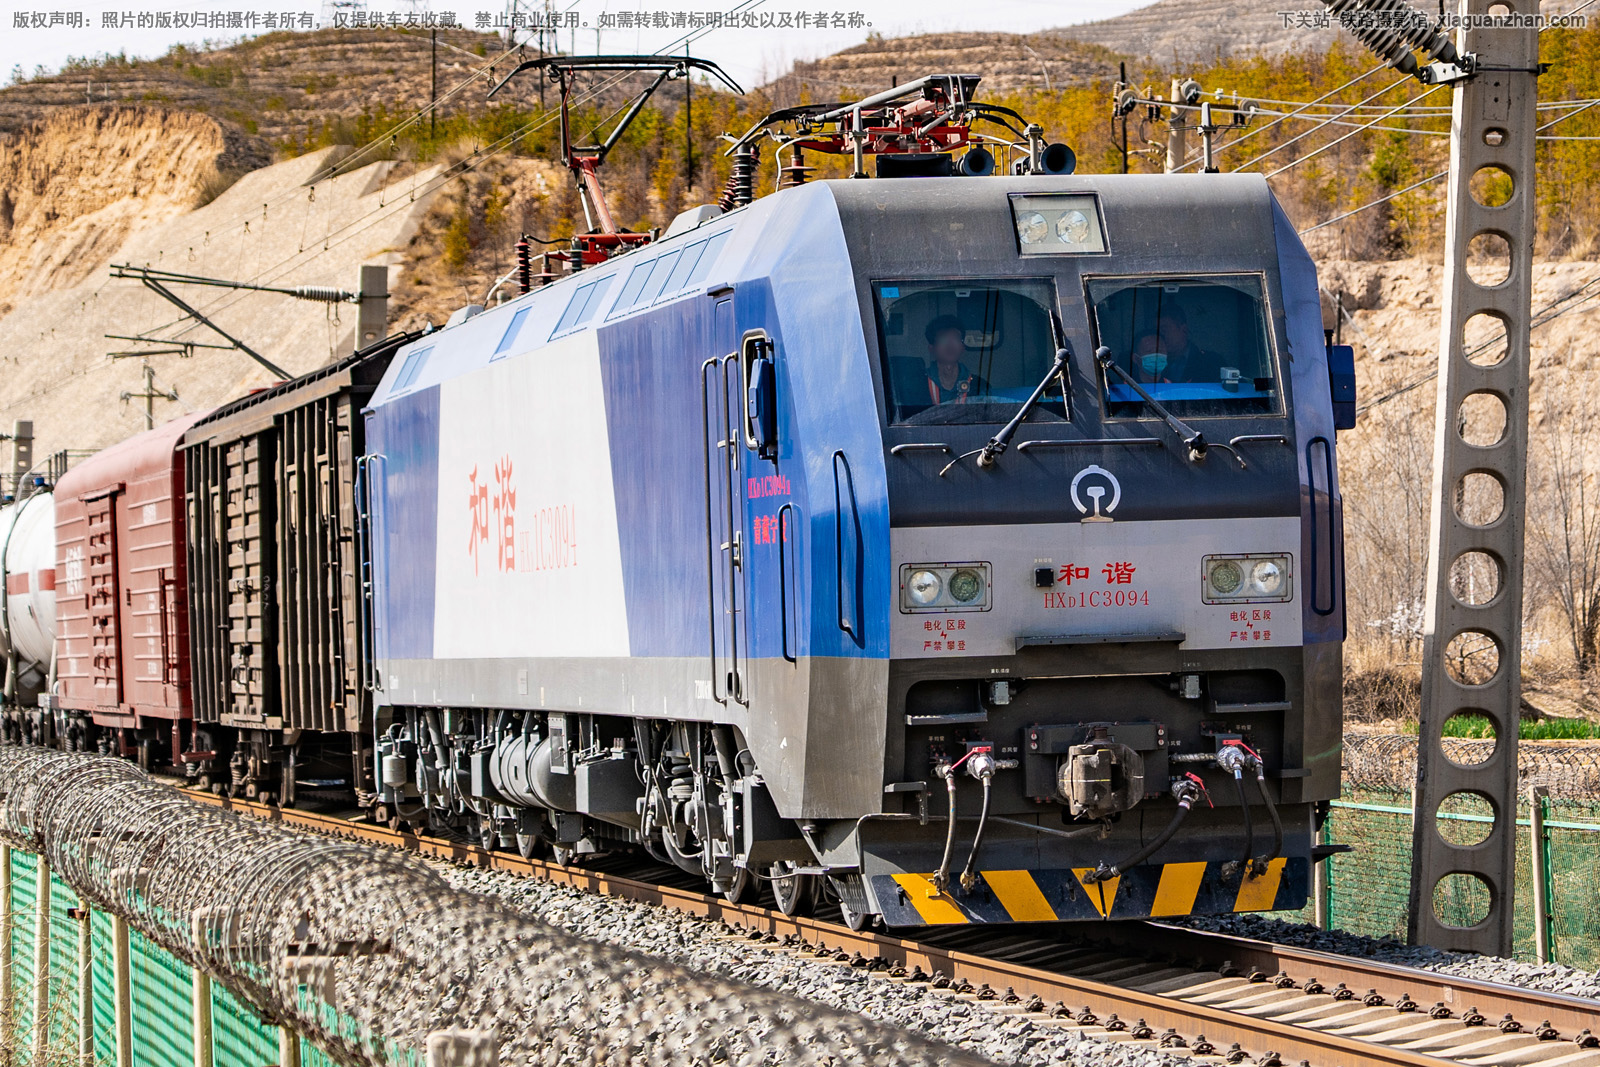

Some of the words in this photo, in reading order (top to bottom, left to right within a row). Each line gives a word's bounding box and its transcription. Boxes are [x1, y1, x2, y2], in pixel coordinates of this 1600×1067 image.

[469, 453, 516, 577] 和谐
[1057, 561, 1136, 586] 和谐
[1044, 590, 1149, 609] HXD1C3094
